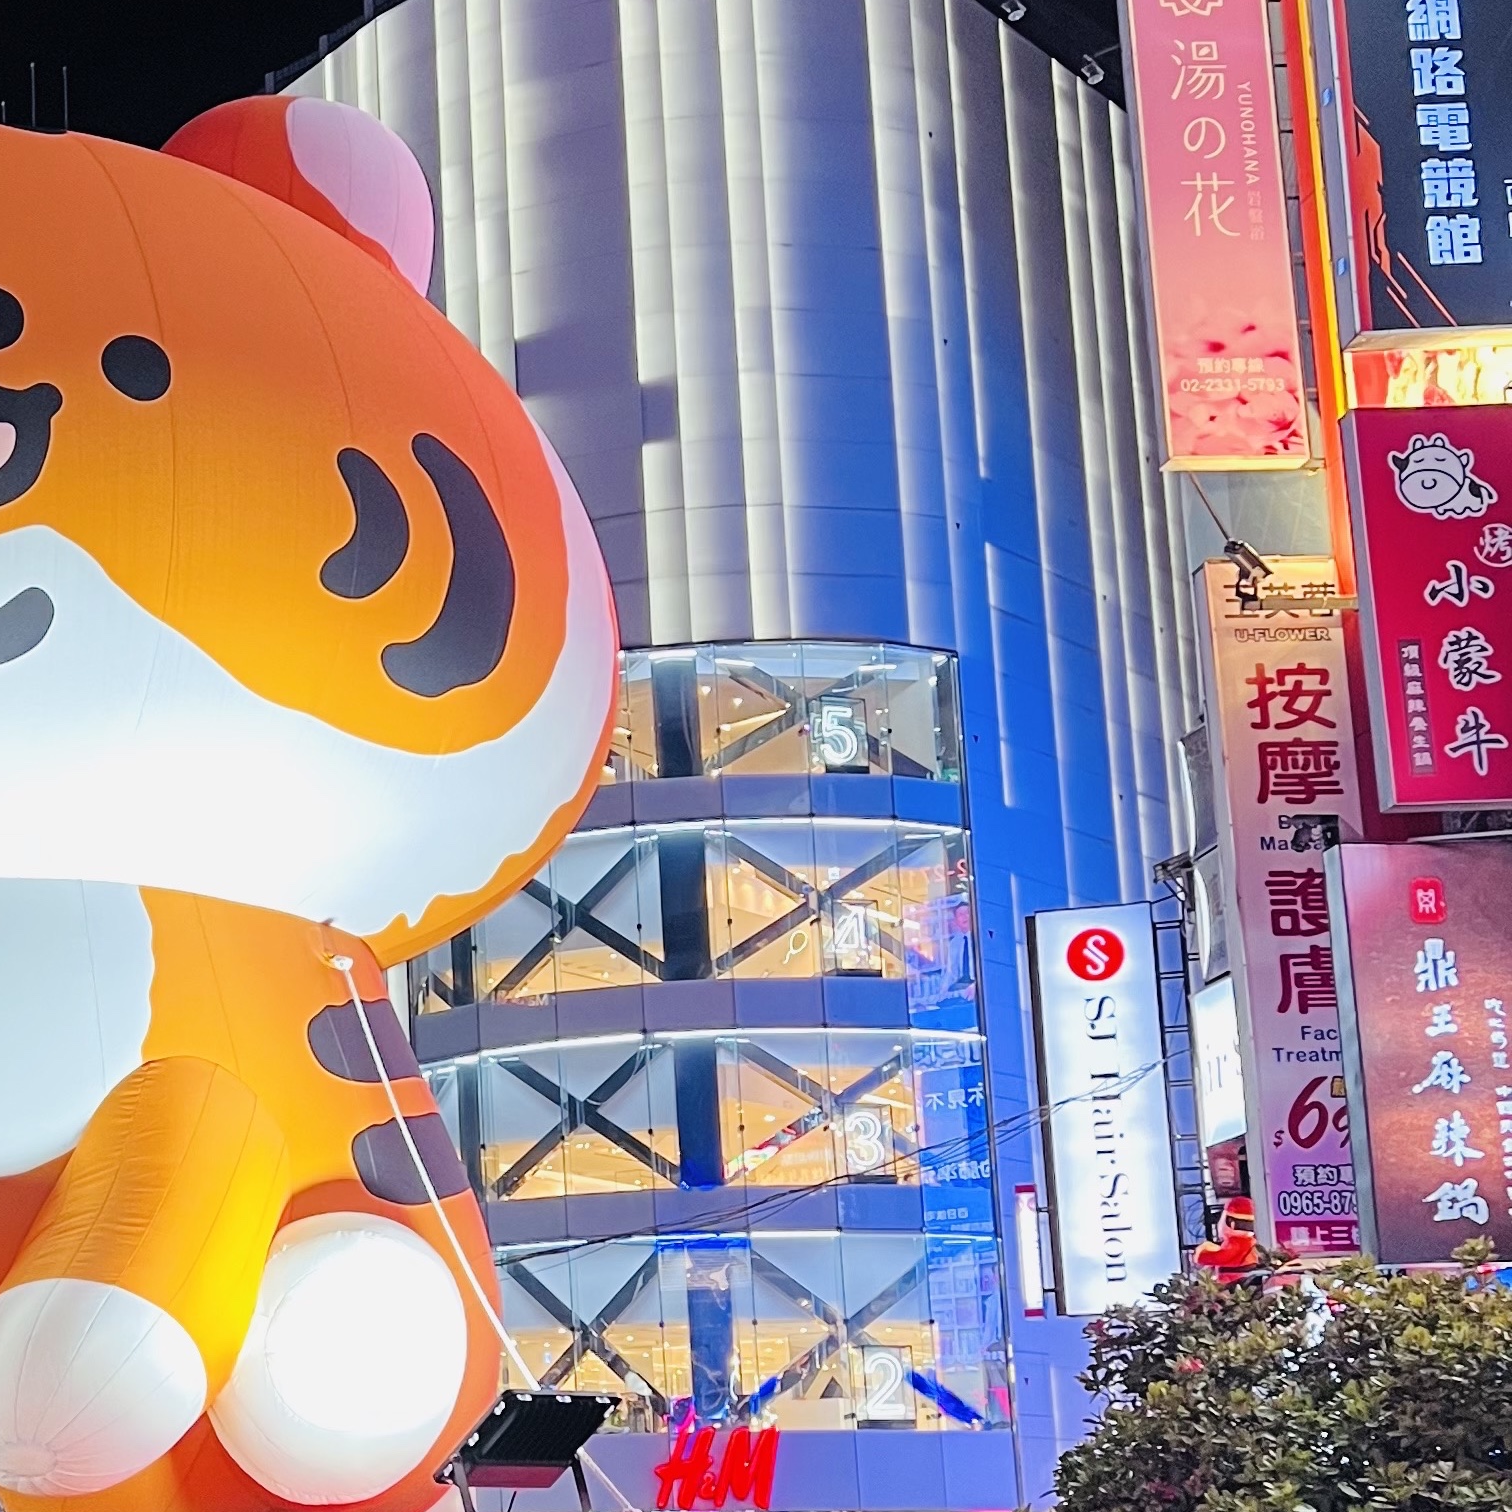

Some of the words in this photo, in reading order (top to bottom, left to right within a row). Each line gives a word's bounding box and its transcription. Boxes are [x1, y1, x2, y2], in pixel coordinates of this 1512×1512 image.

[1170, 38, 1241, 238] 湯の花
[1237, 81, 1261, 185] YUNOHANA
[1406, 0, 1482, 265] 網路電競館
[1234, 627, 1332, 643] U-FLOWER
[1424, 560, 1509, 776] 小蒙牛
[820, 704, 859, 765] 5
[1245, 662, 1344, 804] 按摩
[1265, 867, 1337, 1014] 護膚
[1090, 1069, 1125, 1165] Hair
[1412, 937, 1490, 1225] 鼎王麻辣鍋
[846, 1110, 885, 1172] 3
[1098, 1172, 1133, 1283] Salon
[864, 1351, 906, 1419] 2
[654, 1424, 781, 1511] H&M
